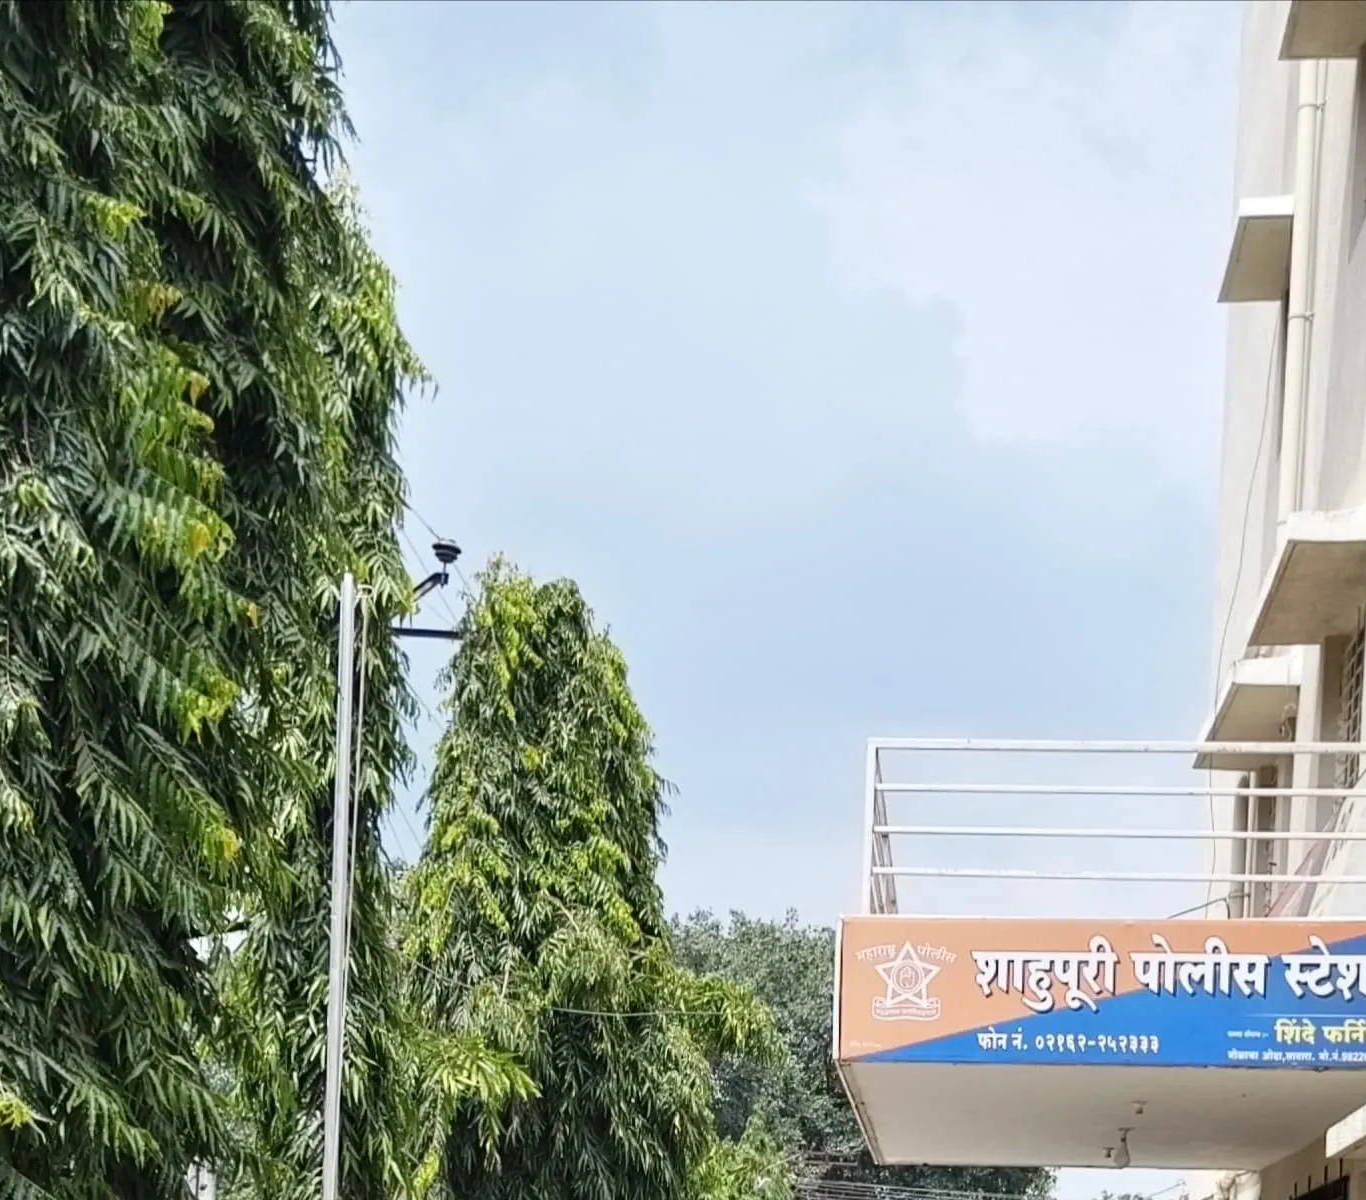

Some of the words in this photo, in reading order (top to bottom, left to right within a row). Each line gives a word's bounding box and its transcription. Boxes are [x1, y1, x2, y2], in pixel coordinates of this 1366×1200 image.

[970, 935, 1120, 1013] शाहुपूरी
[1128, 933, 1270, 997] पोलीस
[977, 1027, 1008, 1050] फोन
[1011, 1027, 1028, 1050] नं.
[1274, 1018, 1317, 1045] शिंदे
